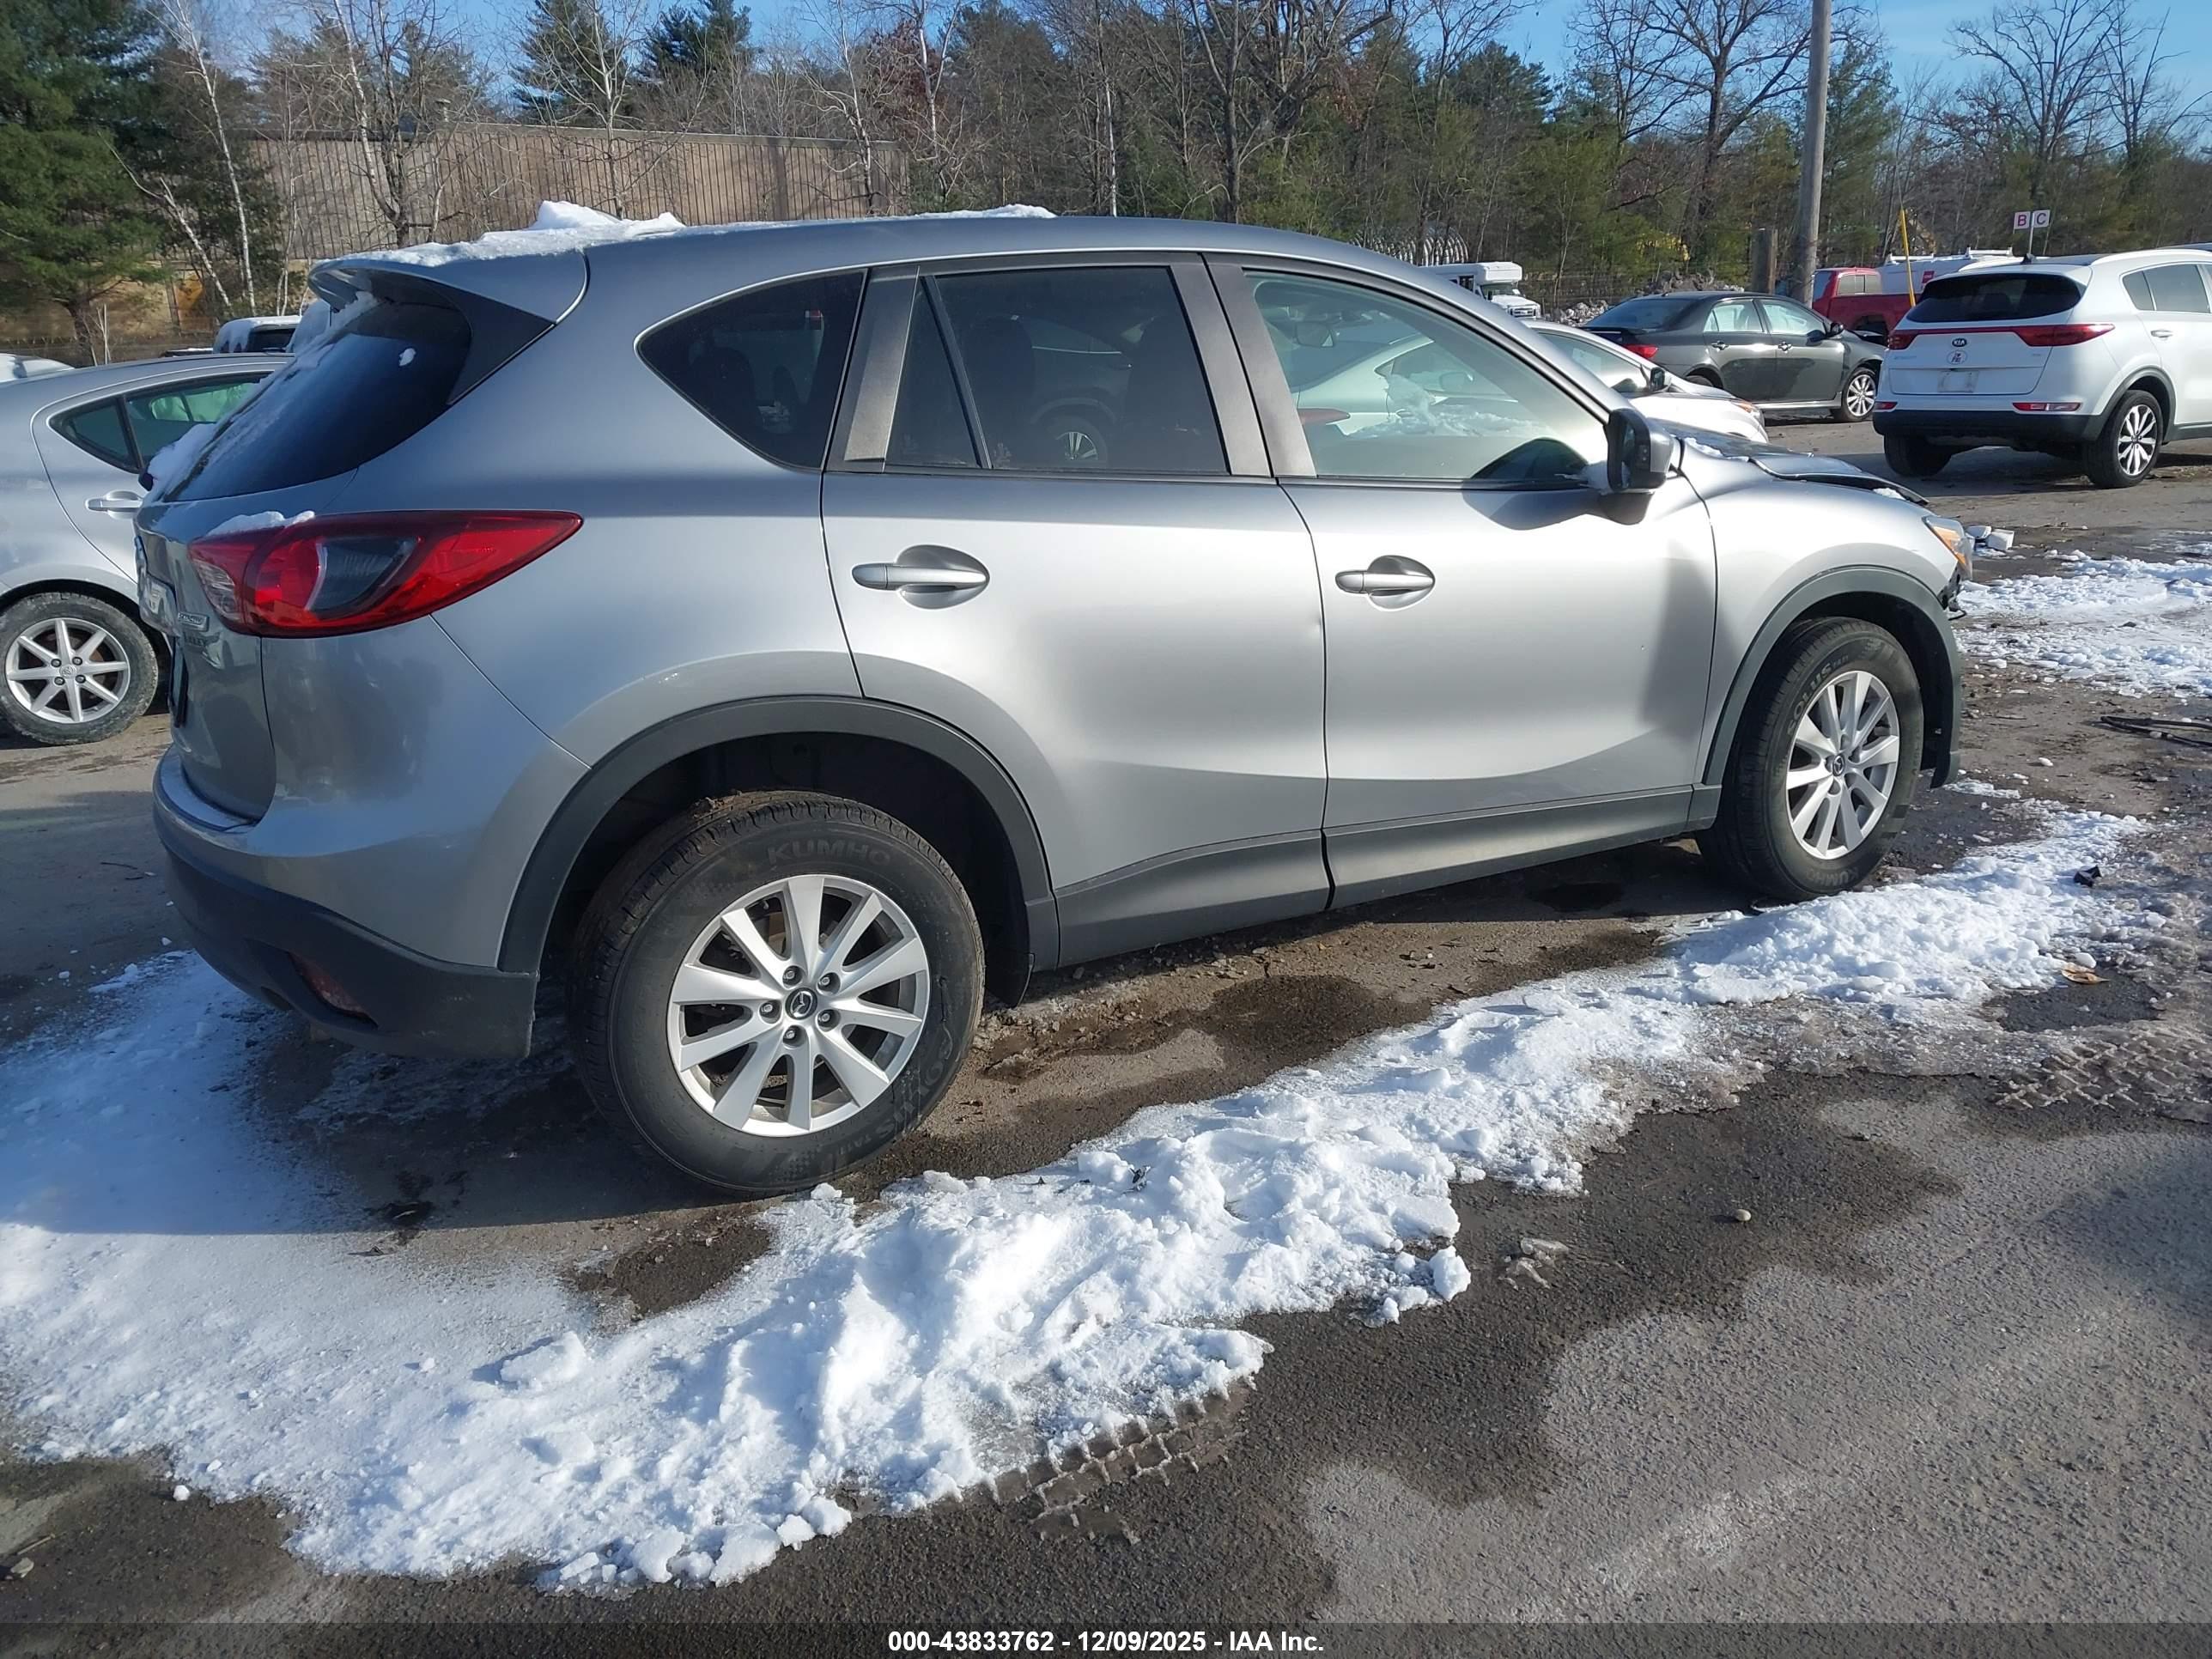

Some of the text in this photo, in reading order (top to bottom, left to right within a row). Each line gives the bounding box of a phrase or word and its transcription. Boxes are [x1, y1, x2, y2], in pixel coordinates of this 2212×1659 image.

[2018, 215, 2027, 227] B
[2036, 213, 2046, 225] C
[1787, 662, 1832, 738] SOLUS
[767, 839, 890, 866] KUMHO
